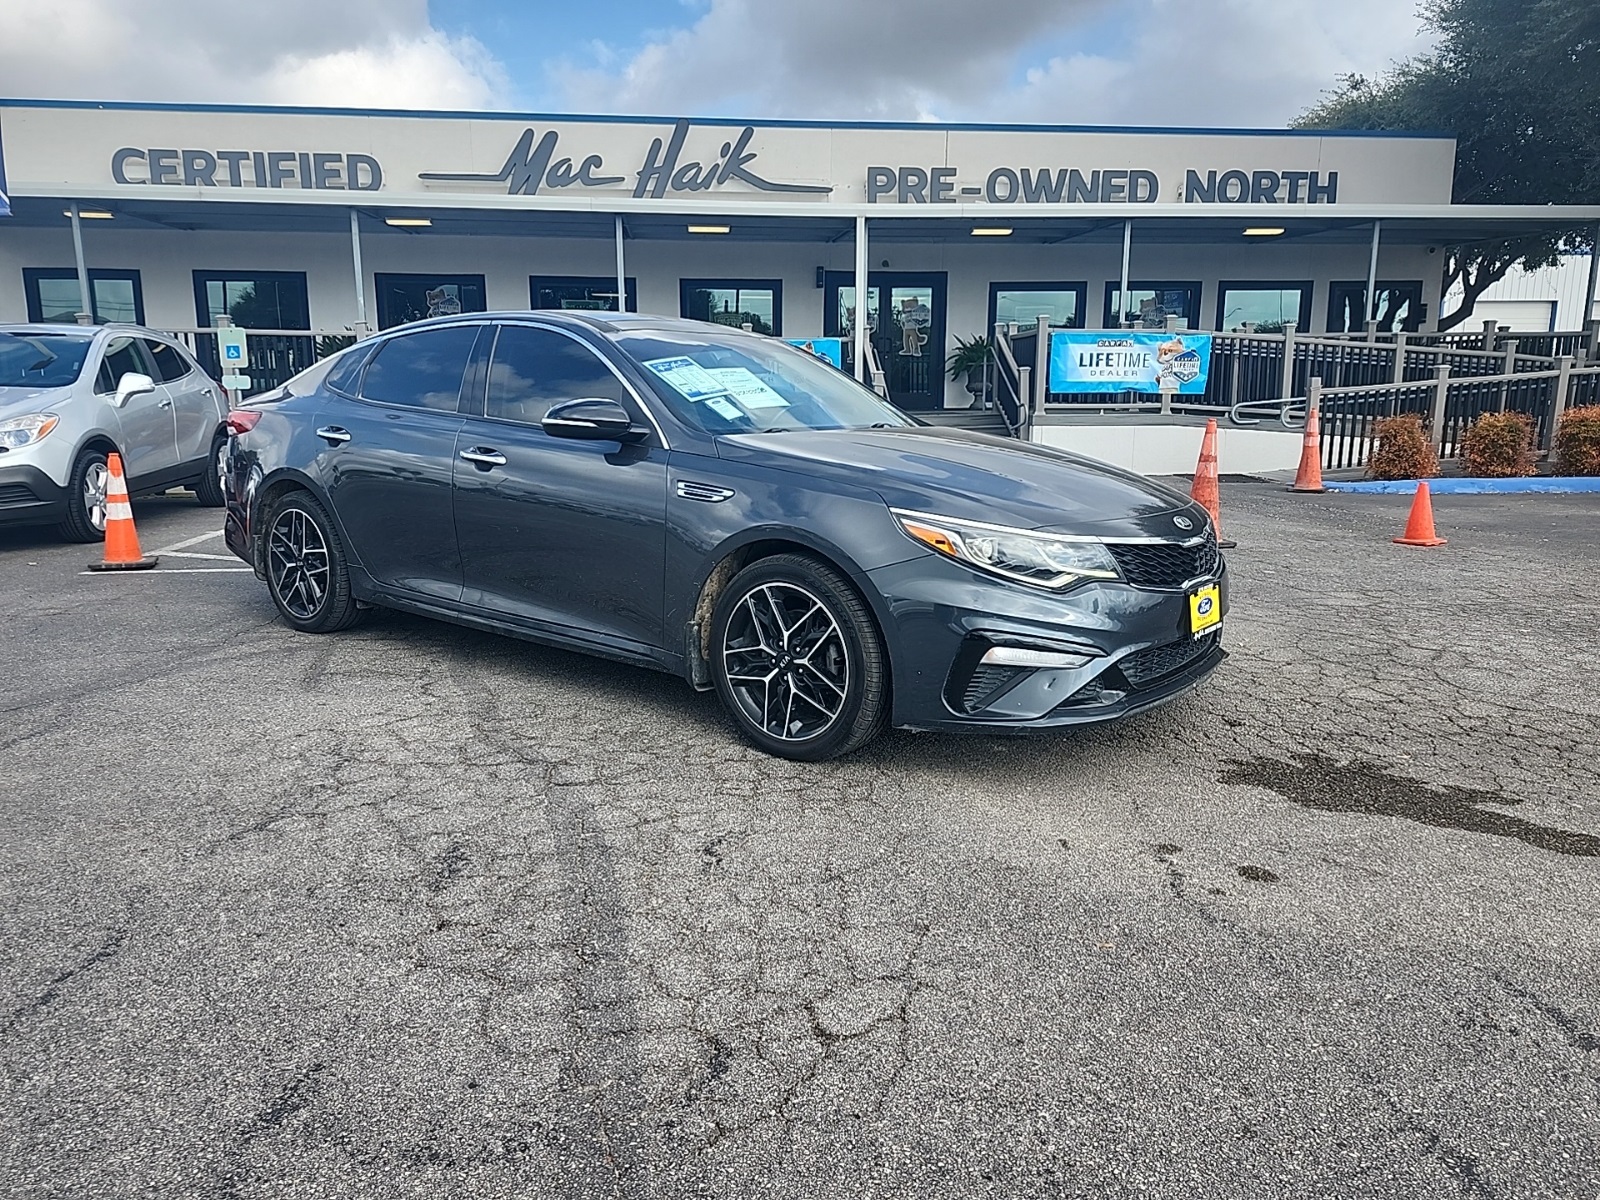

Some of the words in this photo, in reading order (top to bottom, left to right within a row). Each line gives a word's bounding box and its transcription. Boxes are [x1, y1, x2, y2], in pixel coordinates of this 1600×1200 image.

[111, 147, 382, 191] CERTIFIED
[418, 128, 624, 195] Mac
[633, 119, 832, 198] Haik
[867, 167, 1160, 203] PRE-OWNED
[1186, 169, 1338, 203] NORTH
[1079, 352, 1151, 368] LIFETIME
[779, 655, 791, 669] KIA
